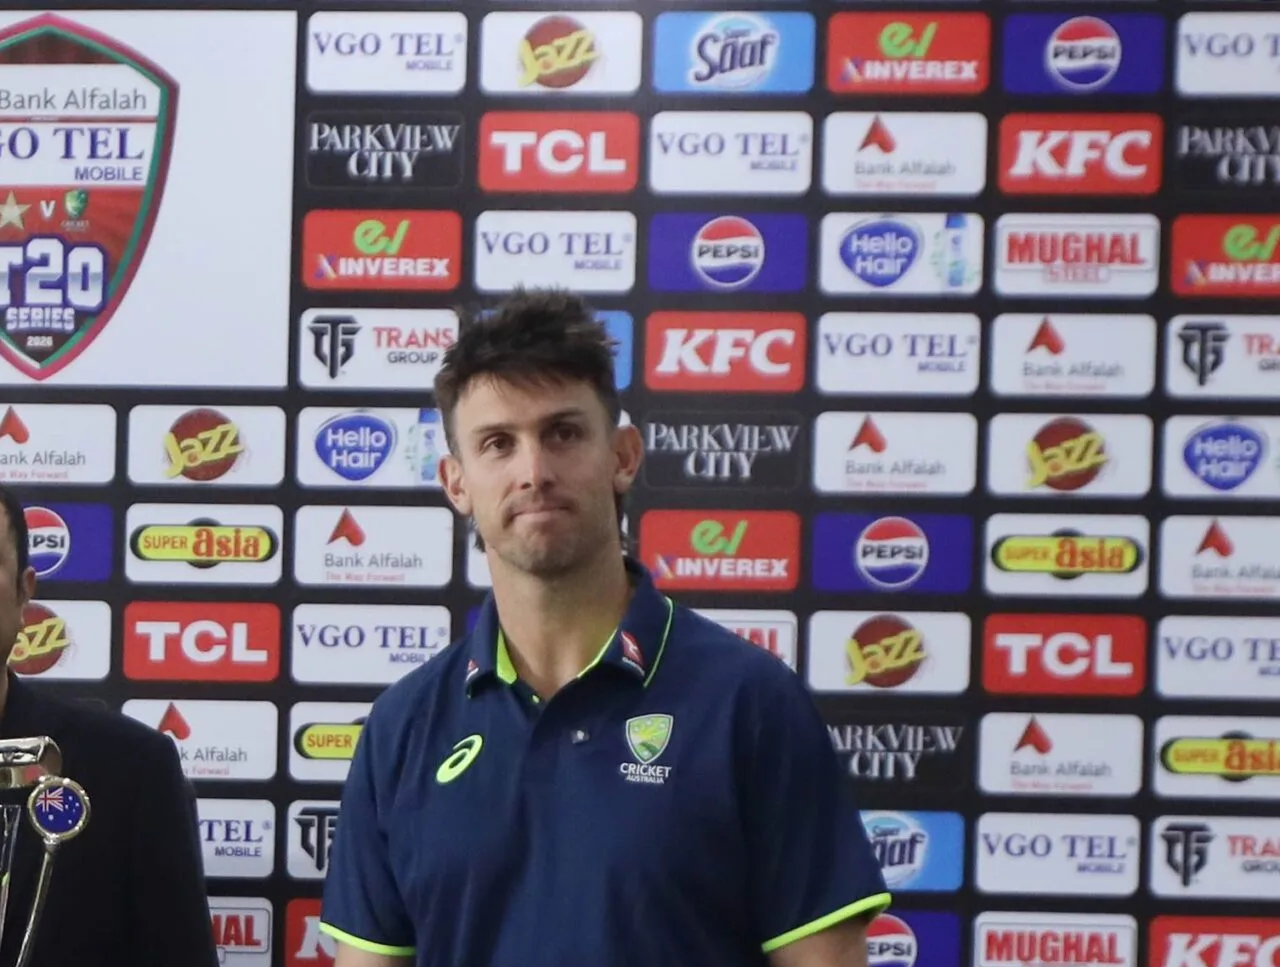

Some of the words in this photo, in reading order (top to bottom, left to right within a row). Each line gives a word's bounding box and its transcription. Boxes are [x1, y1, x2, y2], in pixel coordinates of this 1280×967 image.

[312, 32, 381, 56] VGO
[405, 61, 454, 72] MOBILE
[63, 88, 147, 110] Alfalah
[53, 127, 144, 160] TEL
[490, 130, 625, 174] TCL
[1010, 130, 1151, 178] KFC
[75, 166, 143, 181] MOBILE
[350, 151, 419, 179] CITY
[697, 244, 759, 259] PEPSI
[1007, 231, 1148, 265] MUGHAL
[339, 257, 449, 278] INVEREX
[5, 307, 75, 331] SERIES
[26, 336, 53, 347] 2026
[656, 328, 795, 375] KFC
[327, 426, 385, 449] Hello
[332, 449, 381, 469] Hair
[688, 451, 757, 480] CITY
[143, 534, 188, 550] SUPER
[192, 528, 260, 558] asia
[862, 545, 923, 560] PEPSI
[325, 554, 362, 568] Bank
[368, 554, 422, 568] Alfalah
[1004, 546, 1050, 563] SUPER
[1054, 539, 1125, 572] asia
[677, 558, 786, 579] INVEREX
[135, 621, 268, 664] TCL
[995, 633, 1132, 677] TCL
[826, 724, 964, 751] ARKVIEW
[620, 763, 672, 778] CRICKET
[849, 751, 920, 779] CITY
[625, 775, 665, 784] AUSTRALIA
[982, 834, 1052, 859] VGO
[867, 942, 913, 956] EPSI
[985, 930, 1124, 964] MUGHAL
